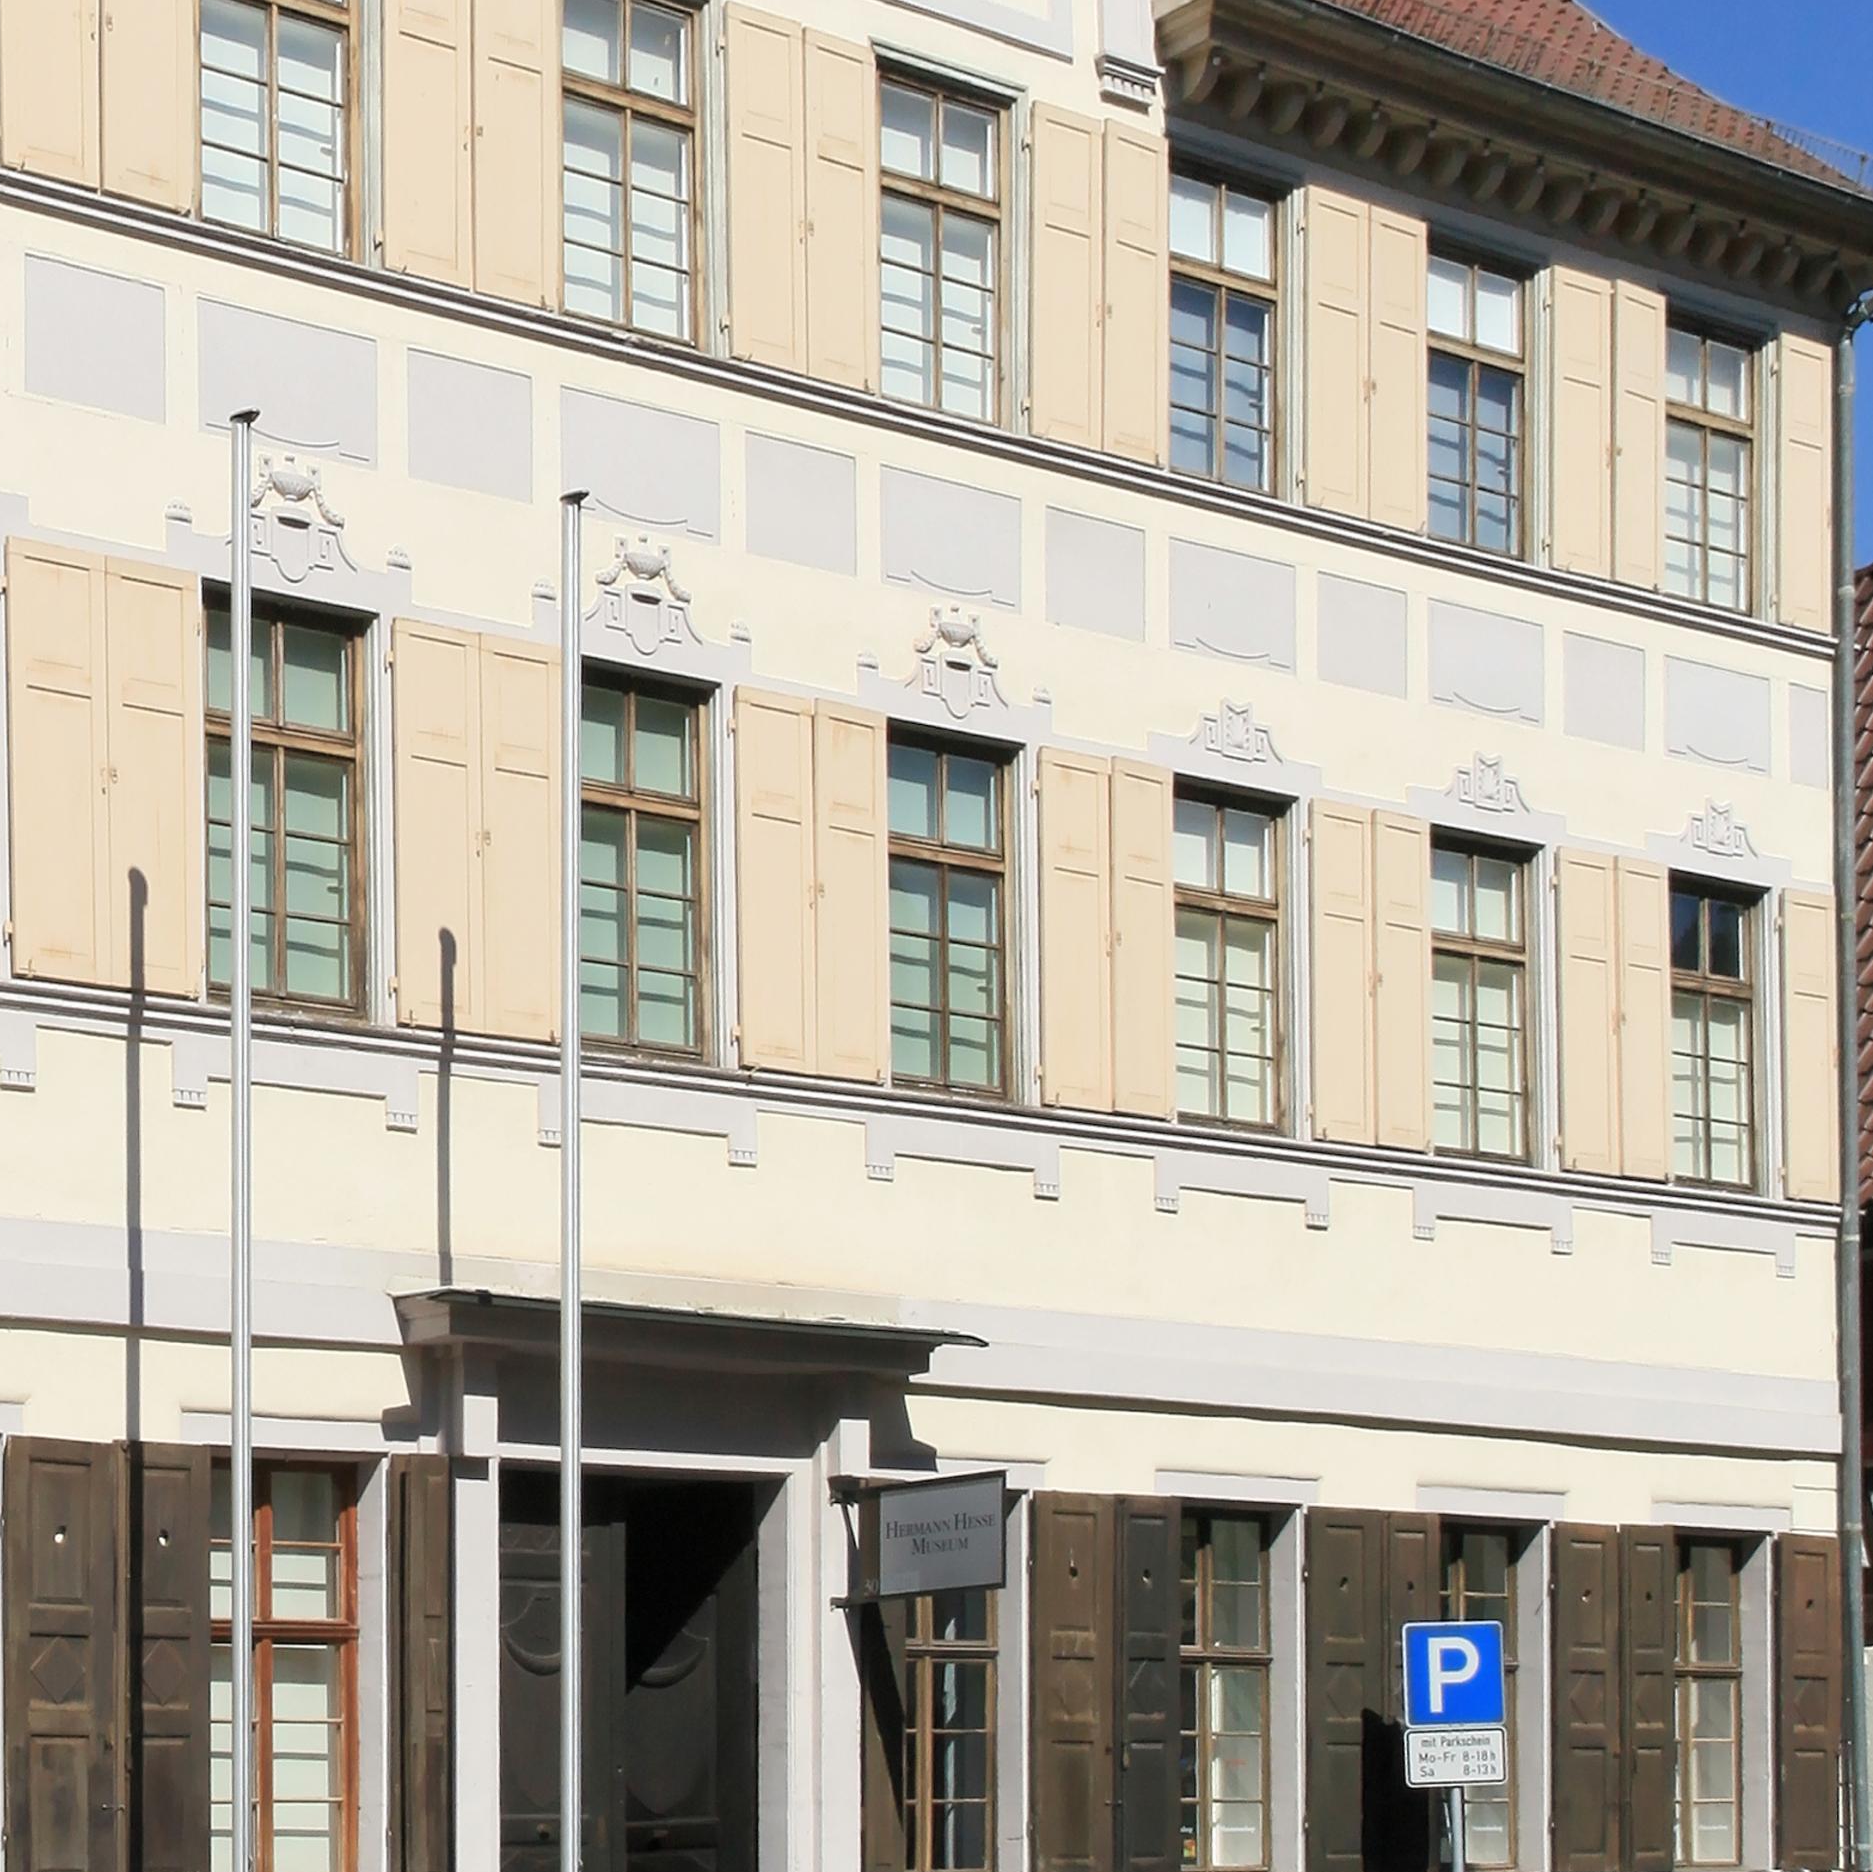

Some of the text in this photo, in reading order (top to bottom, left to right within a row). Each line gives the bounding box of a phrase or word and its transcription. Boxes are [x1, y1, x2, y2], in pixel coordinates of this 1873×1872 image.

[886, 1512, 997, 1539] HERMANN HESSE
[911, 1537, 969, 1555] MUSEUM
[1427, 1636, 1479, 1714] P
[1441, 1735, 1491, 1747] Parkschein
